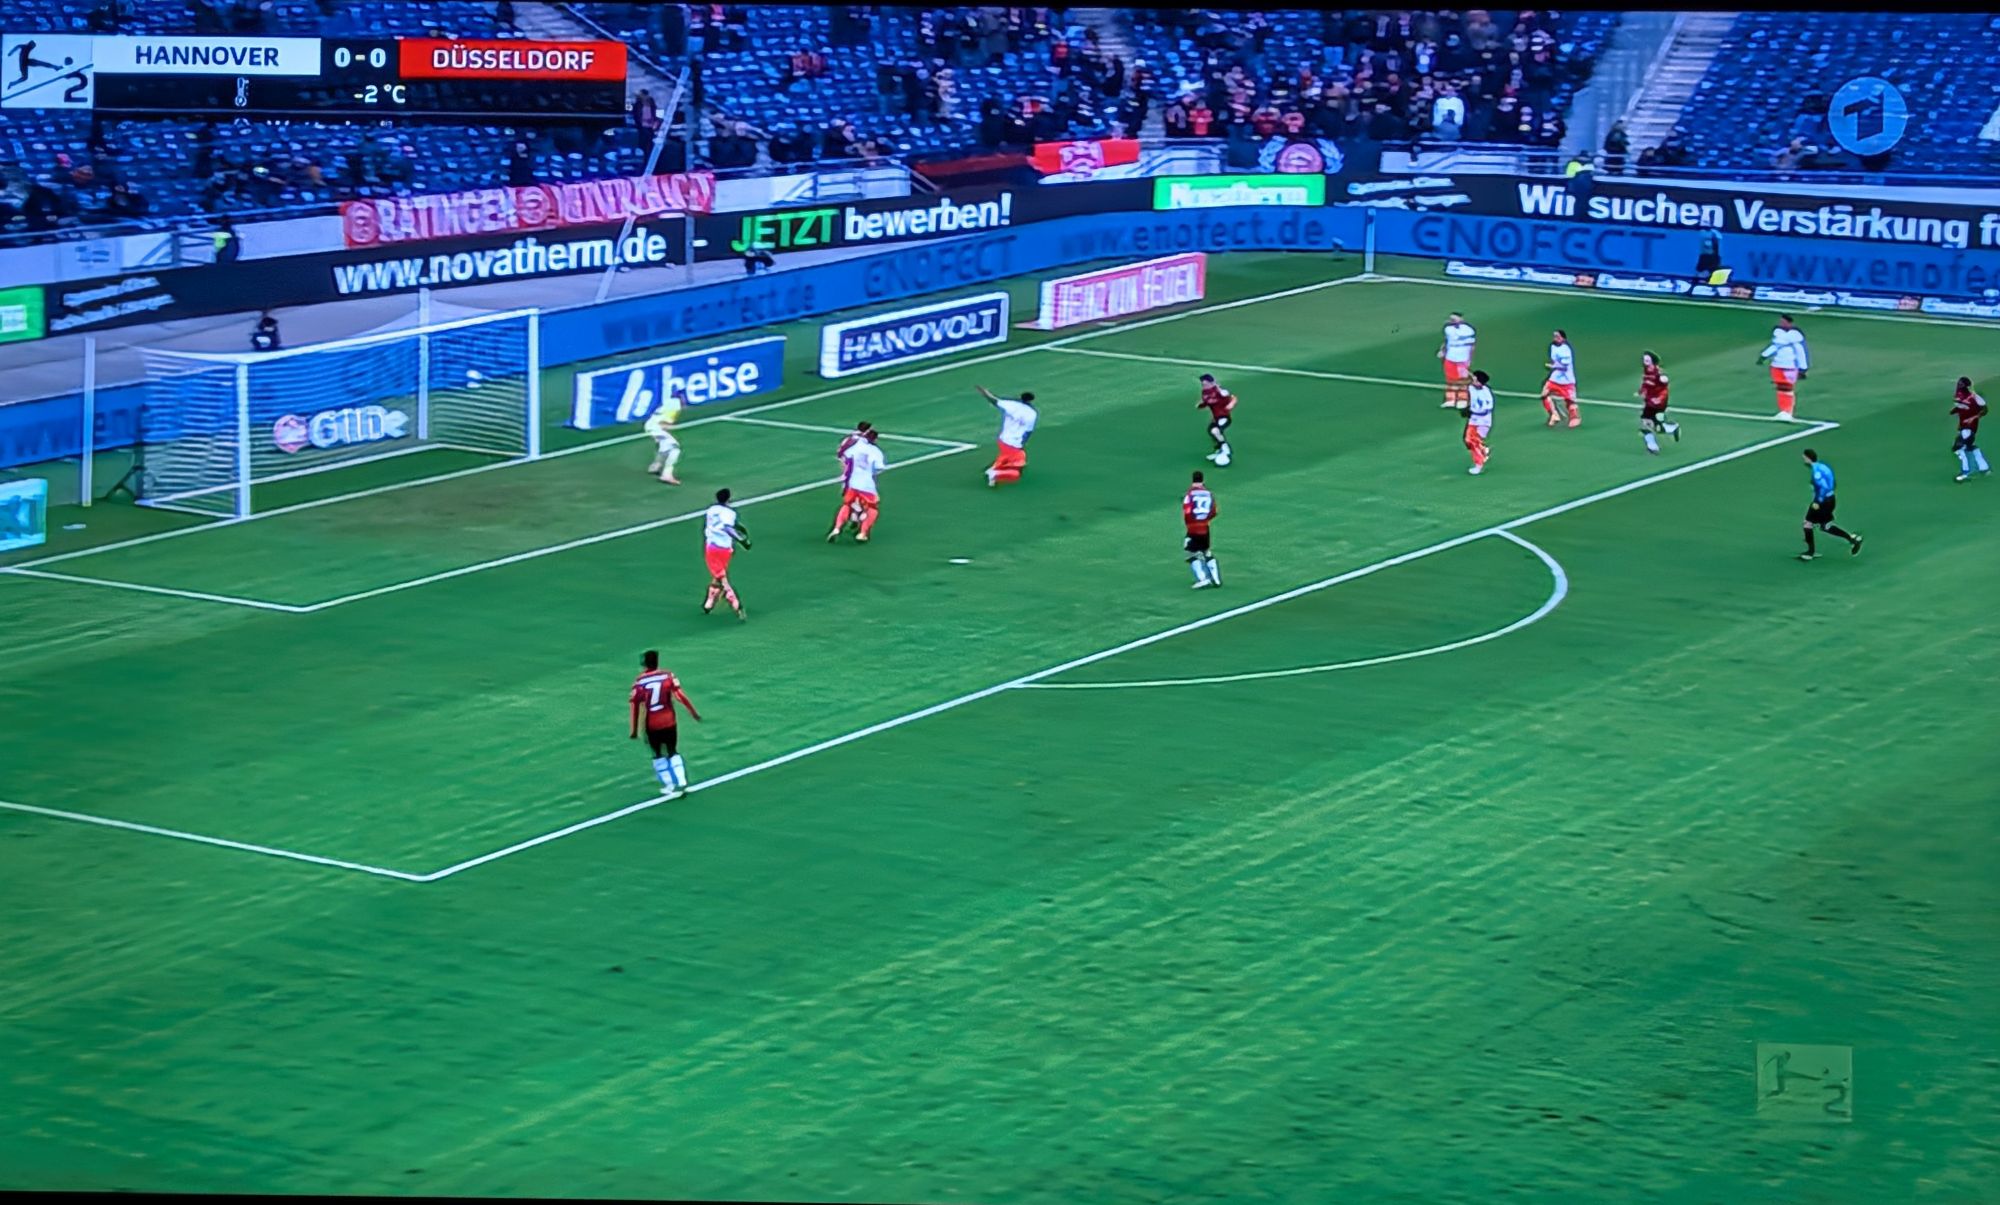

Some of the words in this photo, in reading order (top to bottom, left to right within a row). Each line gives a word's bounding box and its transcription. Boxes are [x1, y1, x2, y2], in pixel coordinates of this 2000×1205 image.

[136, 45, 279, 67] HANNOVER
[432, 44, 595, 70] DÜSSELDORF
[353, 85, 378, 104] -2
[333, 227, 667, 294] www.novatherm.de
[731, 208, 840, 252] JETZT
[844, 192, 1012, 240] bewerben!
[1410, 215, 1667, 270] ENOFECT
[1588, 193, 1724, 228] suchen
[1733, 199, 1970, 249] Verstärkung
[842, 308, 998, 362] HANOVOLT
[661, 357, 759, 405] heise
[644, 681, 662, 706] 7
